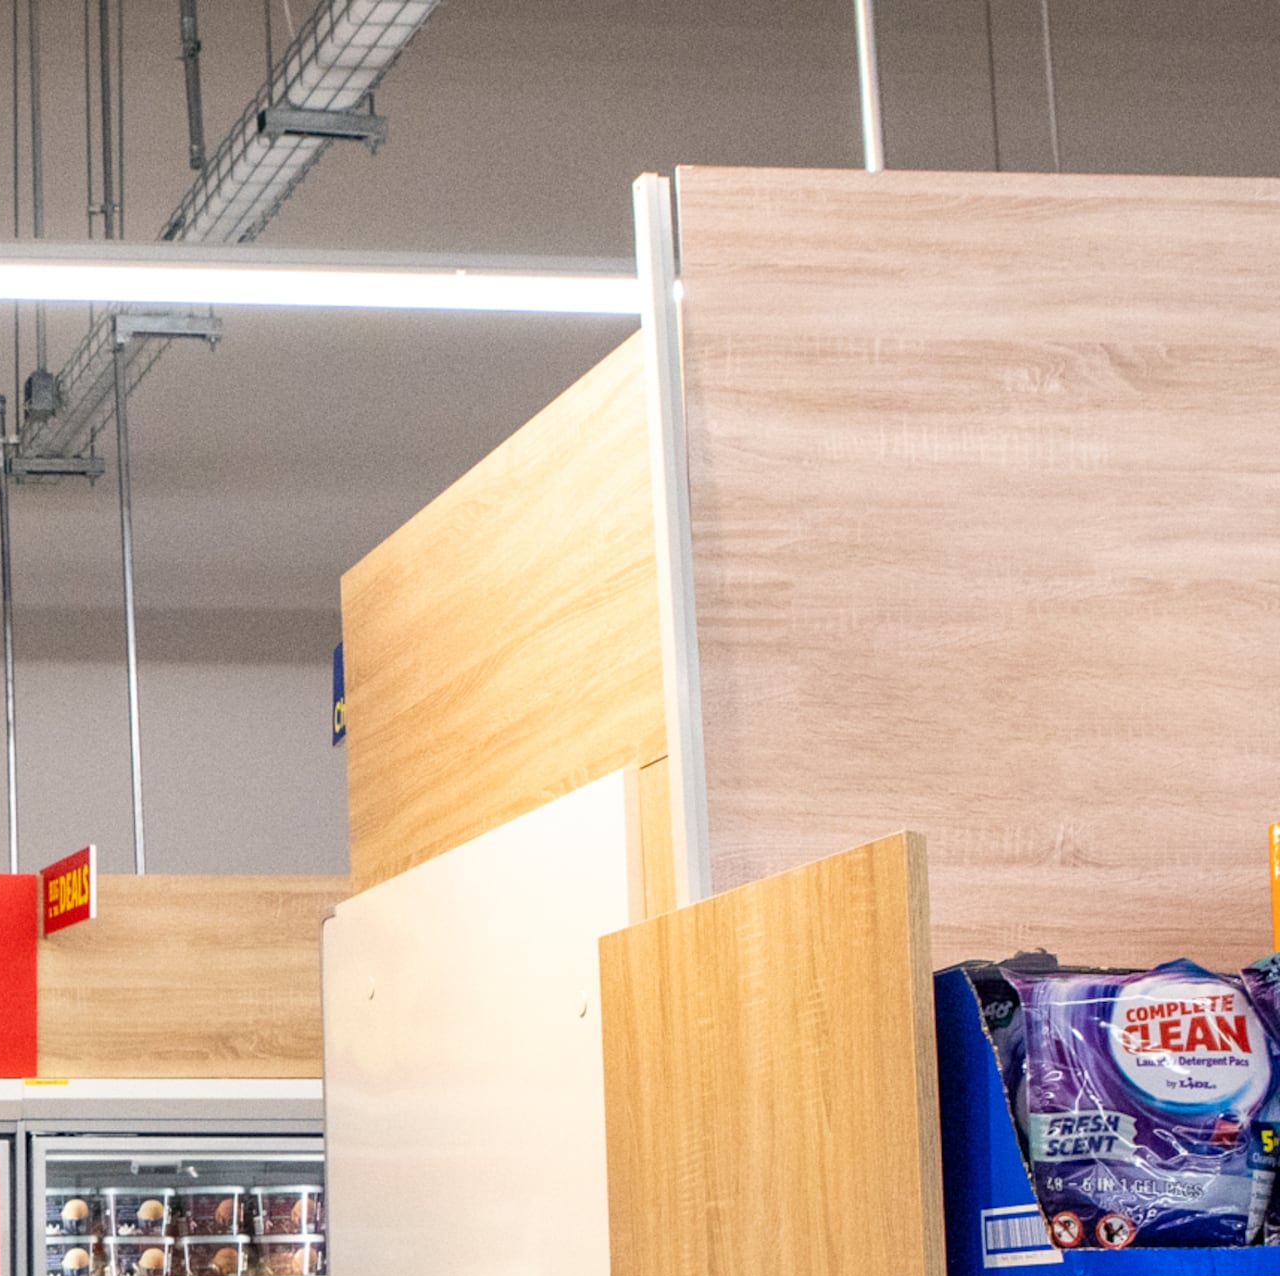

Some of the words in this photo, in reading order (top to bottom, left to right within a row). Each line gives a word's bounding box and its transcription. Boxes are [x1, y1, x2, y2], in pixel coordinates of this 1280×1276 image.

[59, 863, 89, 914] DEALS
[1126, 994, 1234, 1023] COMPLETE
[1122, 1015, 1252, 1055] CLEAN
[1178, 1056, 1227, 1068] Detergent
[1229, 1056, 1249, 1067] Pacs
[1166, 1079, 1177, 1089] by
[1048, 1115, 1120, 1137] FRESH
[1046, 1136, 1118, 1157] SCENT
[1047, 1175, 1064, 1191] 48
[1097, 1177, 1114, 1192] IN
